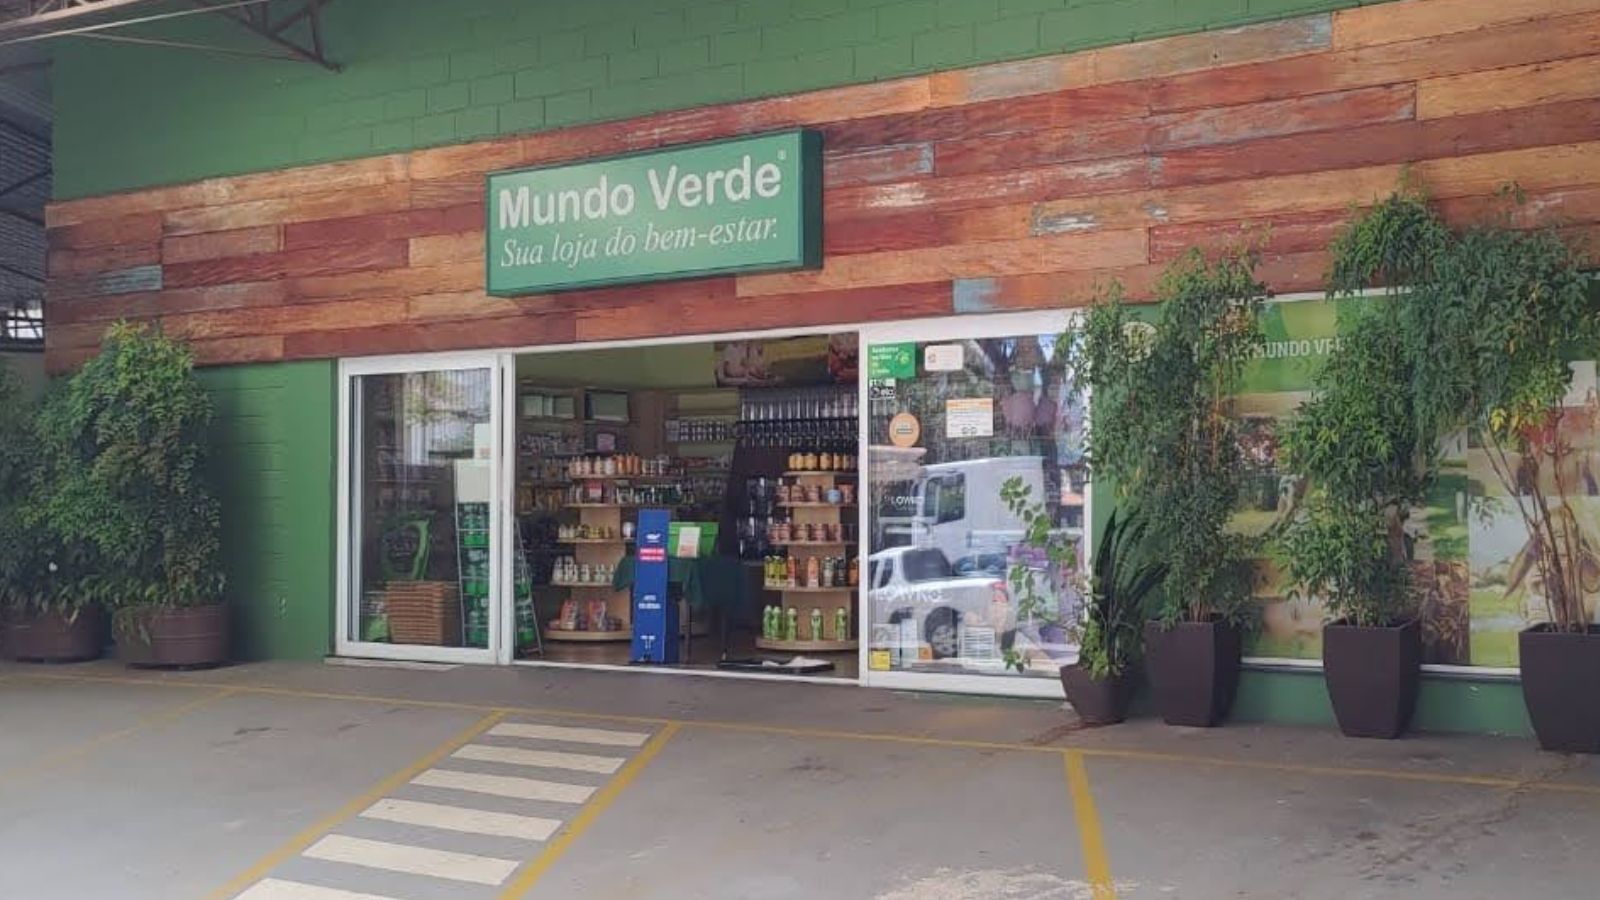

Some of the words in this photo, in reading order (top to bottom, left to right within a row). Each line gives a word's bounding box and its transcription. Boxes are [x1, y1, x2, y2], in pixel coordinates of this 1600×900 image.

[499, 174, 635, 230] Mundo
[647, 155, 782, 211] Verde
[500, 238, 544, 267] Sua
[551, 233, 598, 269] loja
[605, 226, 636, 256] do
[644, 217, 777, 251] bem-estar.
